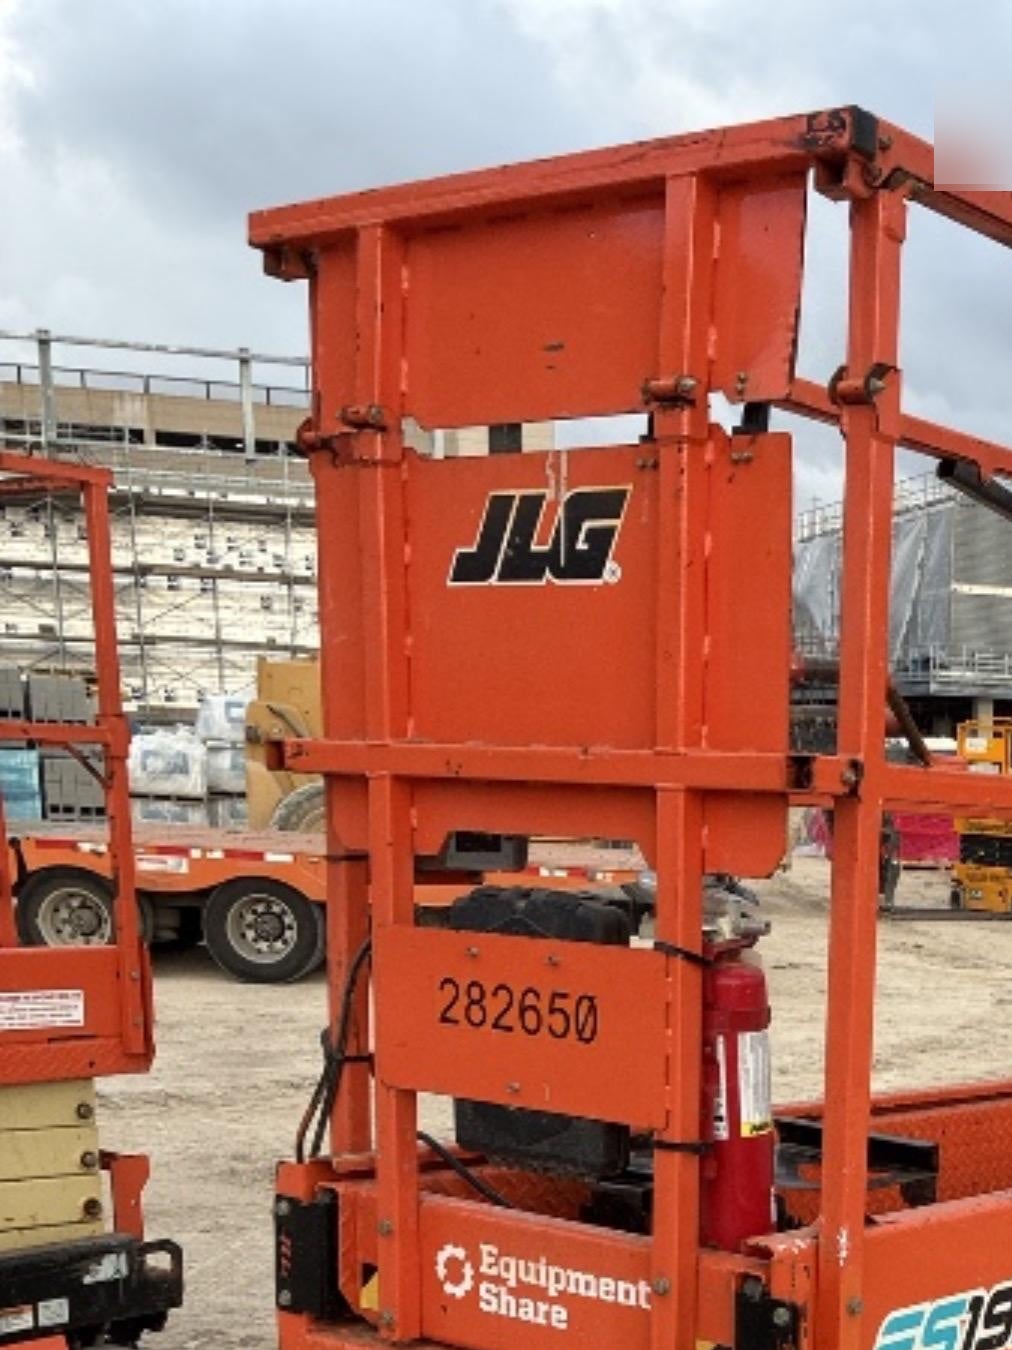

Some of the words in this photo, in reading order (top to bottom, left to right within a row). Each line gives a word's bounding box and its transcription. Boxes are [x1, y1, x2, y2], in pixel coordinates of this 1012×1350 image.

[447, 483, 634, 587] JLG
[439, 977, 598, 1043] 282650
[479, 1243, 652, 1309] Equipment
[479, 1281, 568, 1330] Share
